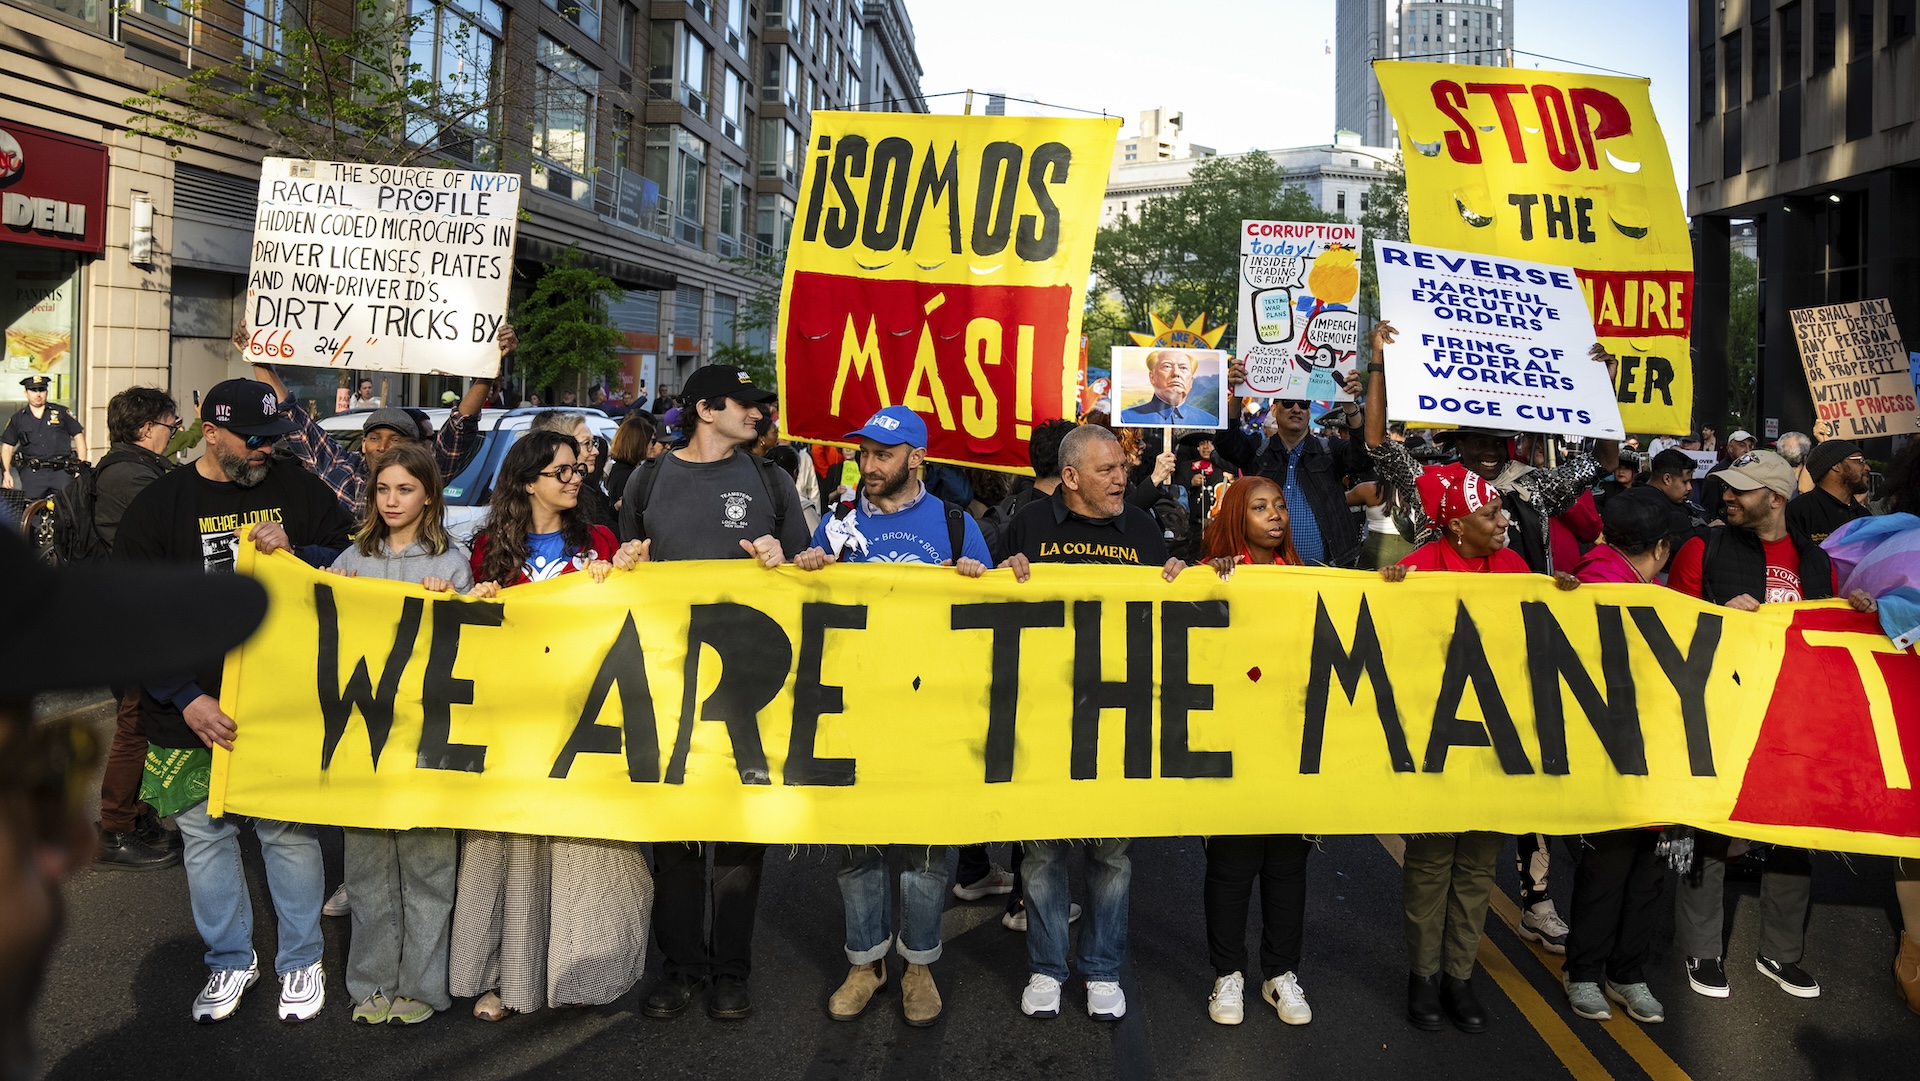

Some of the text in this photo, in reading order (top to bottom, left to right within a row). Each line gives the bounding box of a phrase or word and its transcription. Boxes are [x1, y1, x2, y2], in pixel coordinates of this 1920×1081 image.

[1430, 79, 1632, 172] STOP
[330, 163, 519, 193] THE SOURCE OF NYPD
[272, 181, 492, 216] RACIAL PROFILE
[3, 192, 86, 236] DELI
[1508, 193, 1596, 243] THE
[258, 210, 511, 247] HIDDEN CODED MICROCHIPS IN
[1247, 224, 1355, 239] CORRUPTION
[255, 241, 501, 279] DRIVER LICENSES, PLATES
[1251, 238, 1315, 259] today!
[1249, 267, 1296, 277] TRADING
[1251, 256, 1296, 267] INSIDER
[1382, 247, 1573, 290] REVERSE
[250, 271, 283, 290] AND
[292, 273, 401, 299] NON-DRIVER
[1254, 275, 1290, 285] IS FUN!
[1419, 278, 1547, 306] HARMFUL
[17, 287, 62, 300] PANINIS
[1412, 289, 1560, 321] EXECUTIVE
[26, 303, 55, 314] Special
[1266, 311, 1287, 319] PLANS
[1434, 307, 1543, 331] ORDERS
[1792, 300, 1887, 324] NOR SHALL ANY
[368, 305, 458, 340] TRICKS
[472, 313, 503, 343] BY
[1314, 319, 1356, 331] IMPEACH
[1798, 312, 1897, 339] STATE DEPRIVE
[250, 329, 295, 358] 666
[1171, 332, 1190, 343] ARE
[1421, 334, 1564, 360] FIRING OF
[1802, 329, 1891, 354] ANY PERSON
[829, 292, 1035, 442] MÁS!
[1434, 349, 1560, 374] FEDERAL
[1805, 340, 1903, 369] OF LIFE LIBERTY
[1251, 366, 1285, 374] PRISON
[1253, 375, 1282, 384] CAMP!
[1423, 363, 1574, 391] WORKERS
[1606, 354, 1673, 406] ER
[1809, 357, 1894, 381] OR PROPERTY
[1813, 377, 1881, 402] WITHOUT
[215, 404, 231, 416] NYC
[1419, 395, 1591, 424] DOGE CUTS
[1818, 395, 1915, 420] DUE PROCESS
[1825, 416, 1887, 437] OF LAW
[720, 492, 752, 501] TEAMSTERS
[199, 514, 239, 533] MICHAEL
[881, 531, 918, 543] BRONX
[1040, 542, 1139, 563] LA COLMENA
[1773, 569, 1801, 588] YORK
[314, 582, 504, 774] WE
[549, 602, 867, 786] ARE
[951, 600, 1232, 783] THE
[1299, 591, 1724, 777] MANY
